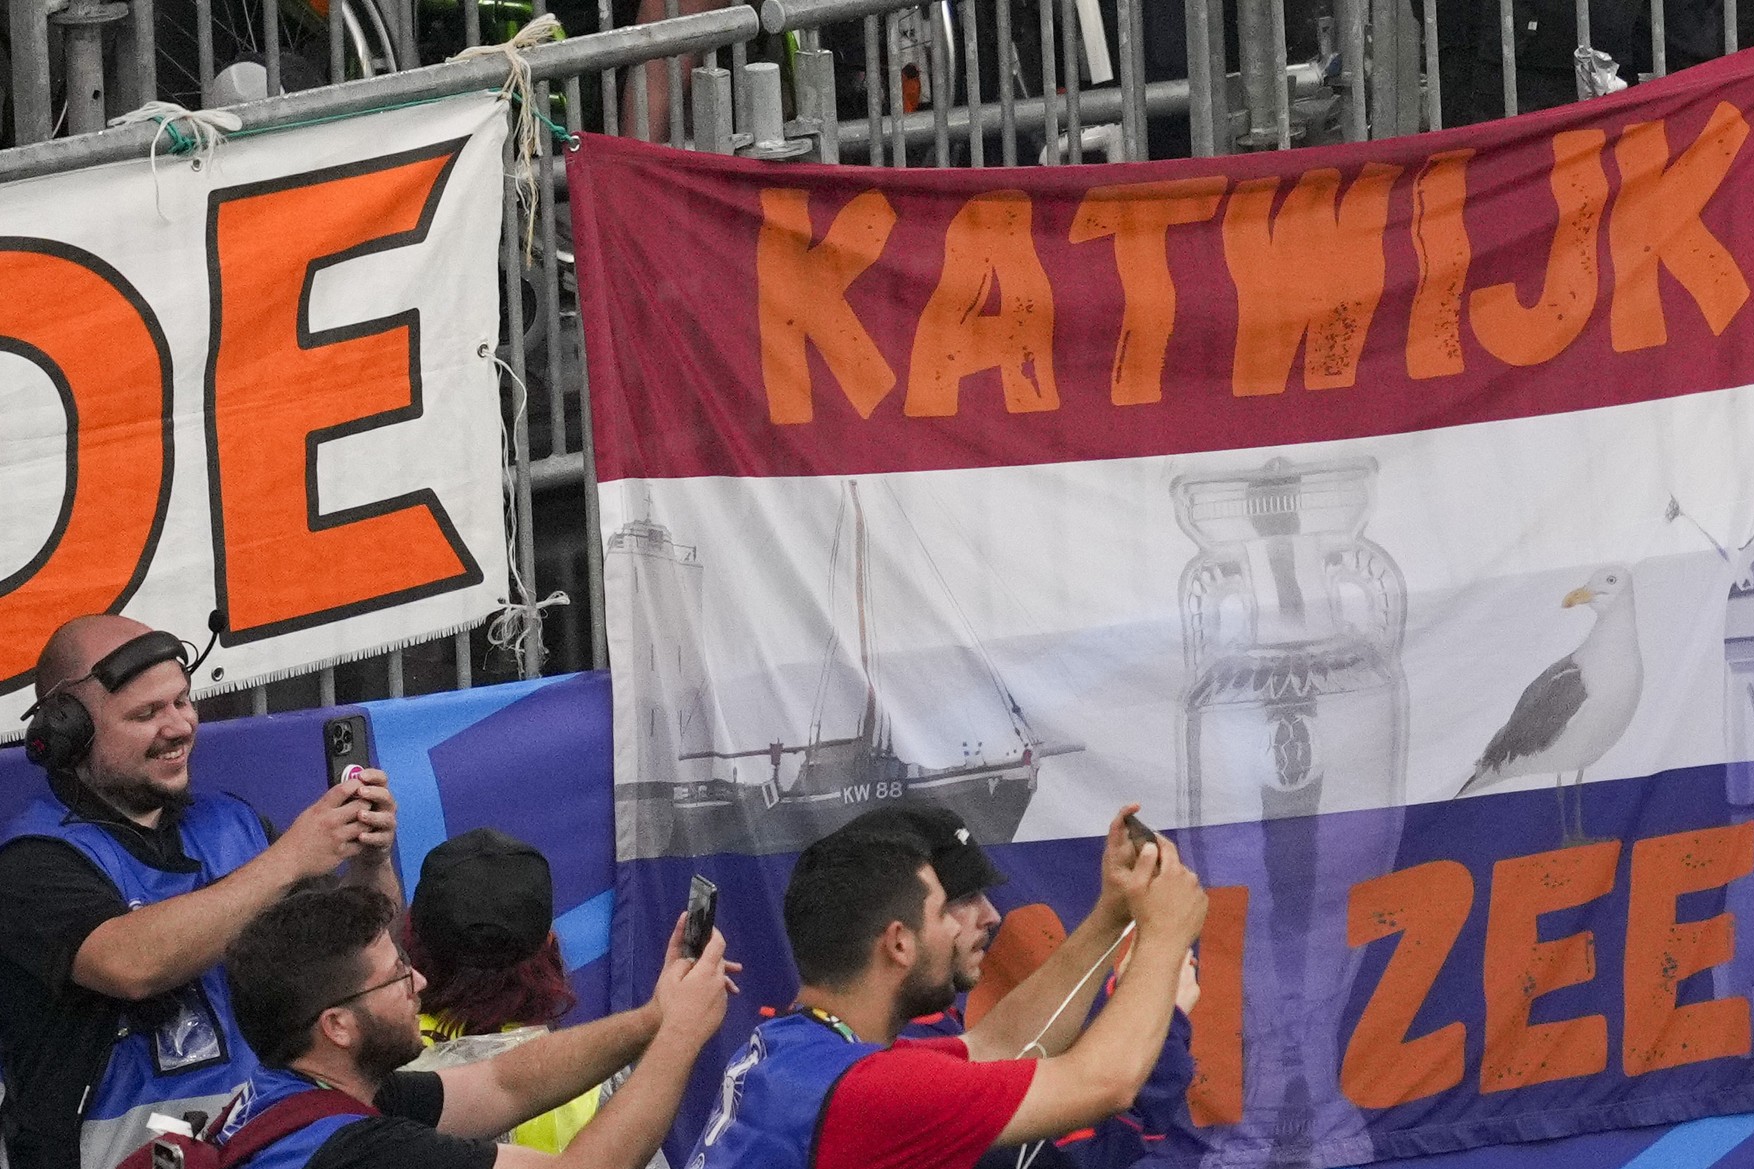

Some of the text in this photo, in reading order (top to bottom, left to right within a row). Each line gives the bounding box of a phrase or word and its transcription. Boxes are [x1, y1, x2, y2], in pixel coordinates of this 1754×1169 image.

[757, 100, 1751, 424] KATWIJK
[842, 782, 902, 804] KW 88
